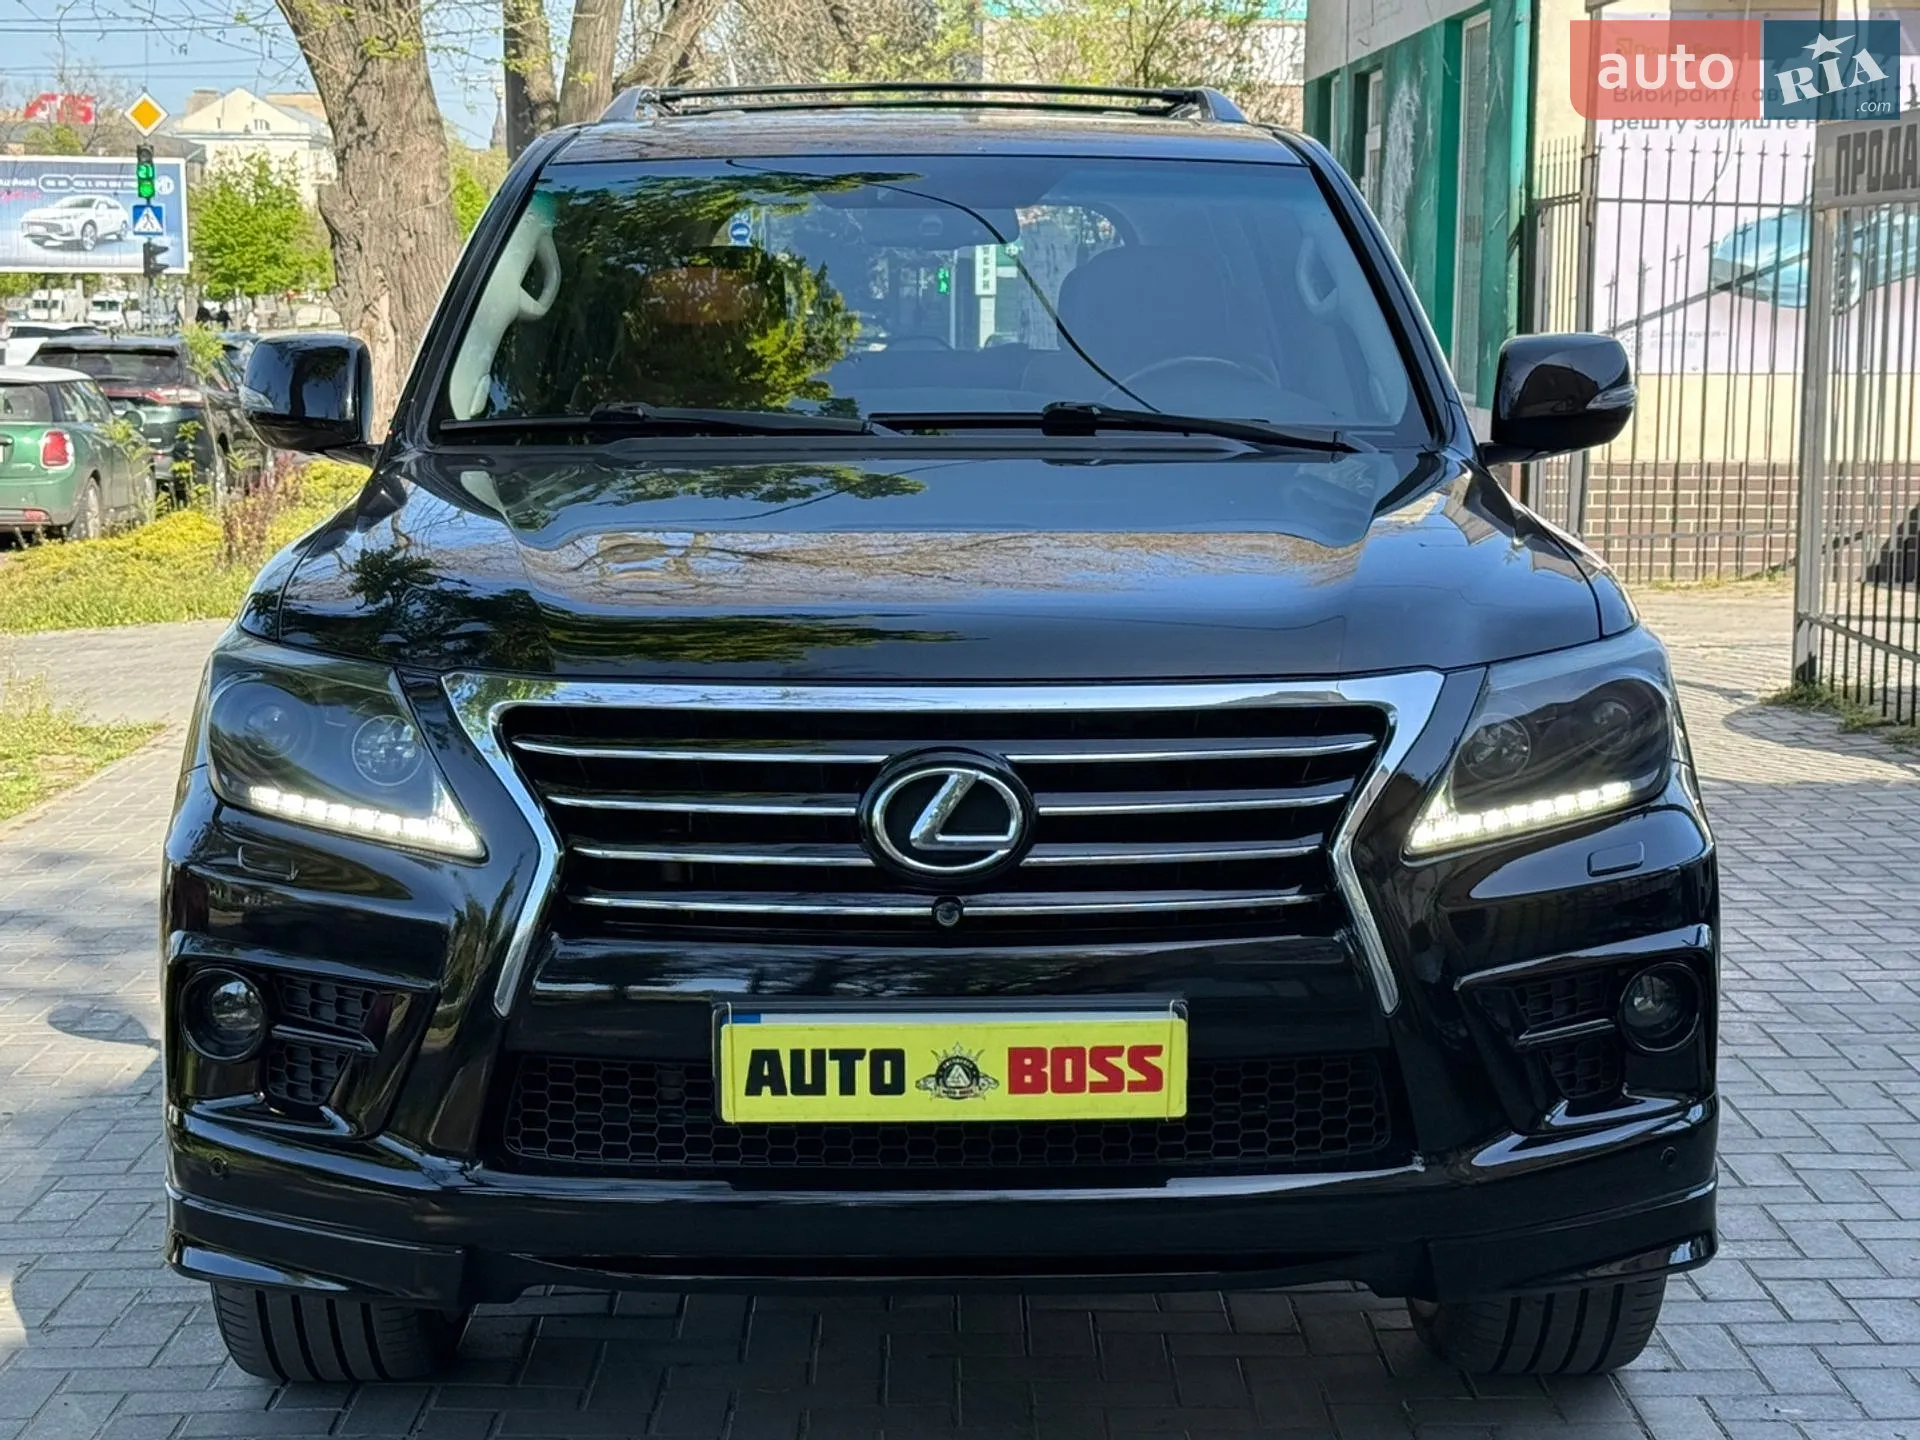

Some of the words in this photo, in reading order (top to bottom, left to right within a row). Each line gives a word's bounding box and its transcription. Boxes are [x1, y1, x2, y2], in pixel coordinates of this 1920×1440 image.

[1834, 123, 1920, 197] ПРОДА
[744, 1048, 906, 1097] AUTO
[1008, 1045, 1165, 1095] BOSS
